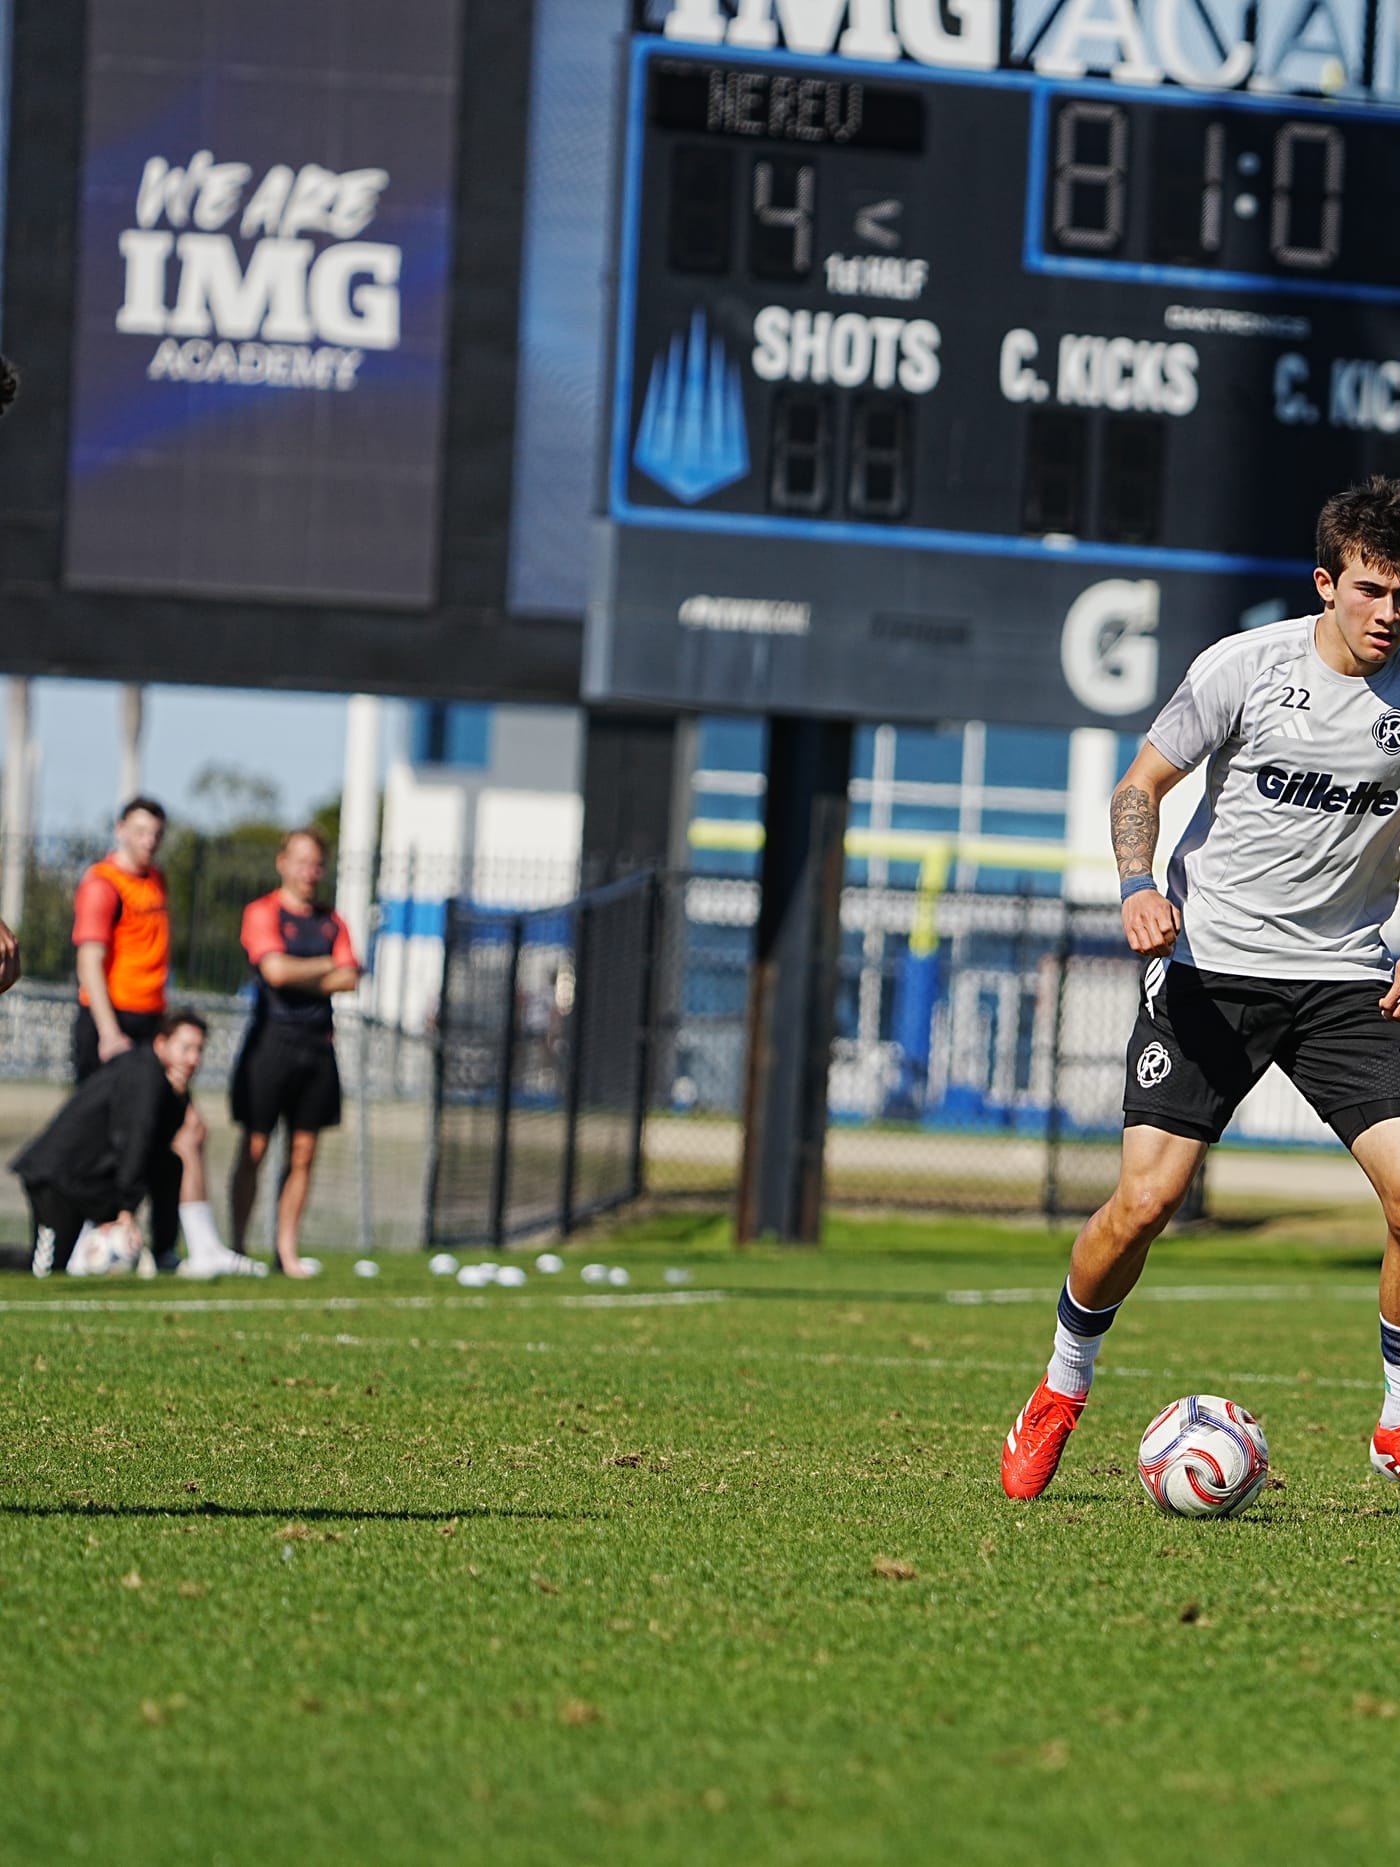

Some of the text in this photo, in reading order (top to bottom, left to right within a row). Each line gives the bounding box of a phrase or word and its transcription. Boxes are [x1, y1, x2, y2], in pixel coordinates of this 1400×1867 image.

[135, 150, 390, 239] WE ARE
[753, 160, 814, 273] 4
[116, 230, 401, 349] IMG
[862, 255, 929, 300] HALF
[147, 337, 365, 391] ACADEMY
[752, 306, 941, 394] SHOTS
[1000, 329, 1200, 416] C. KICKS
[1274, 352, 1320, 424] C.
[1060, 578, 1160, 716] G
[1279, 686, 1312, 712] 22
[1256, 765, 1399, 817] Gillette
